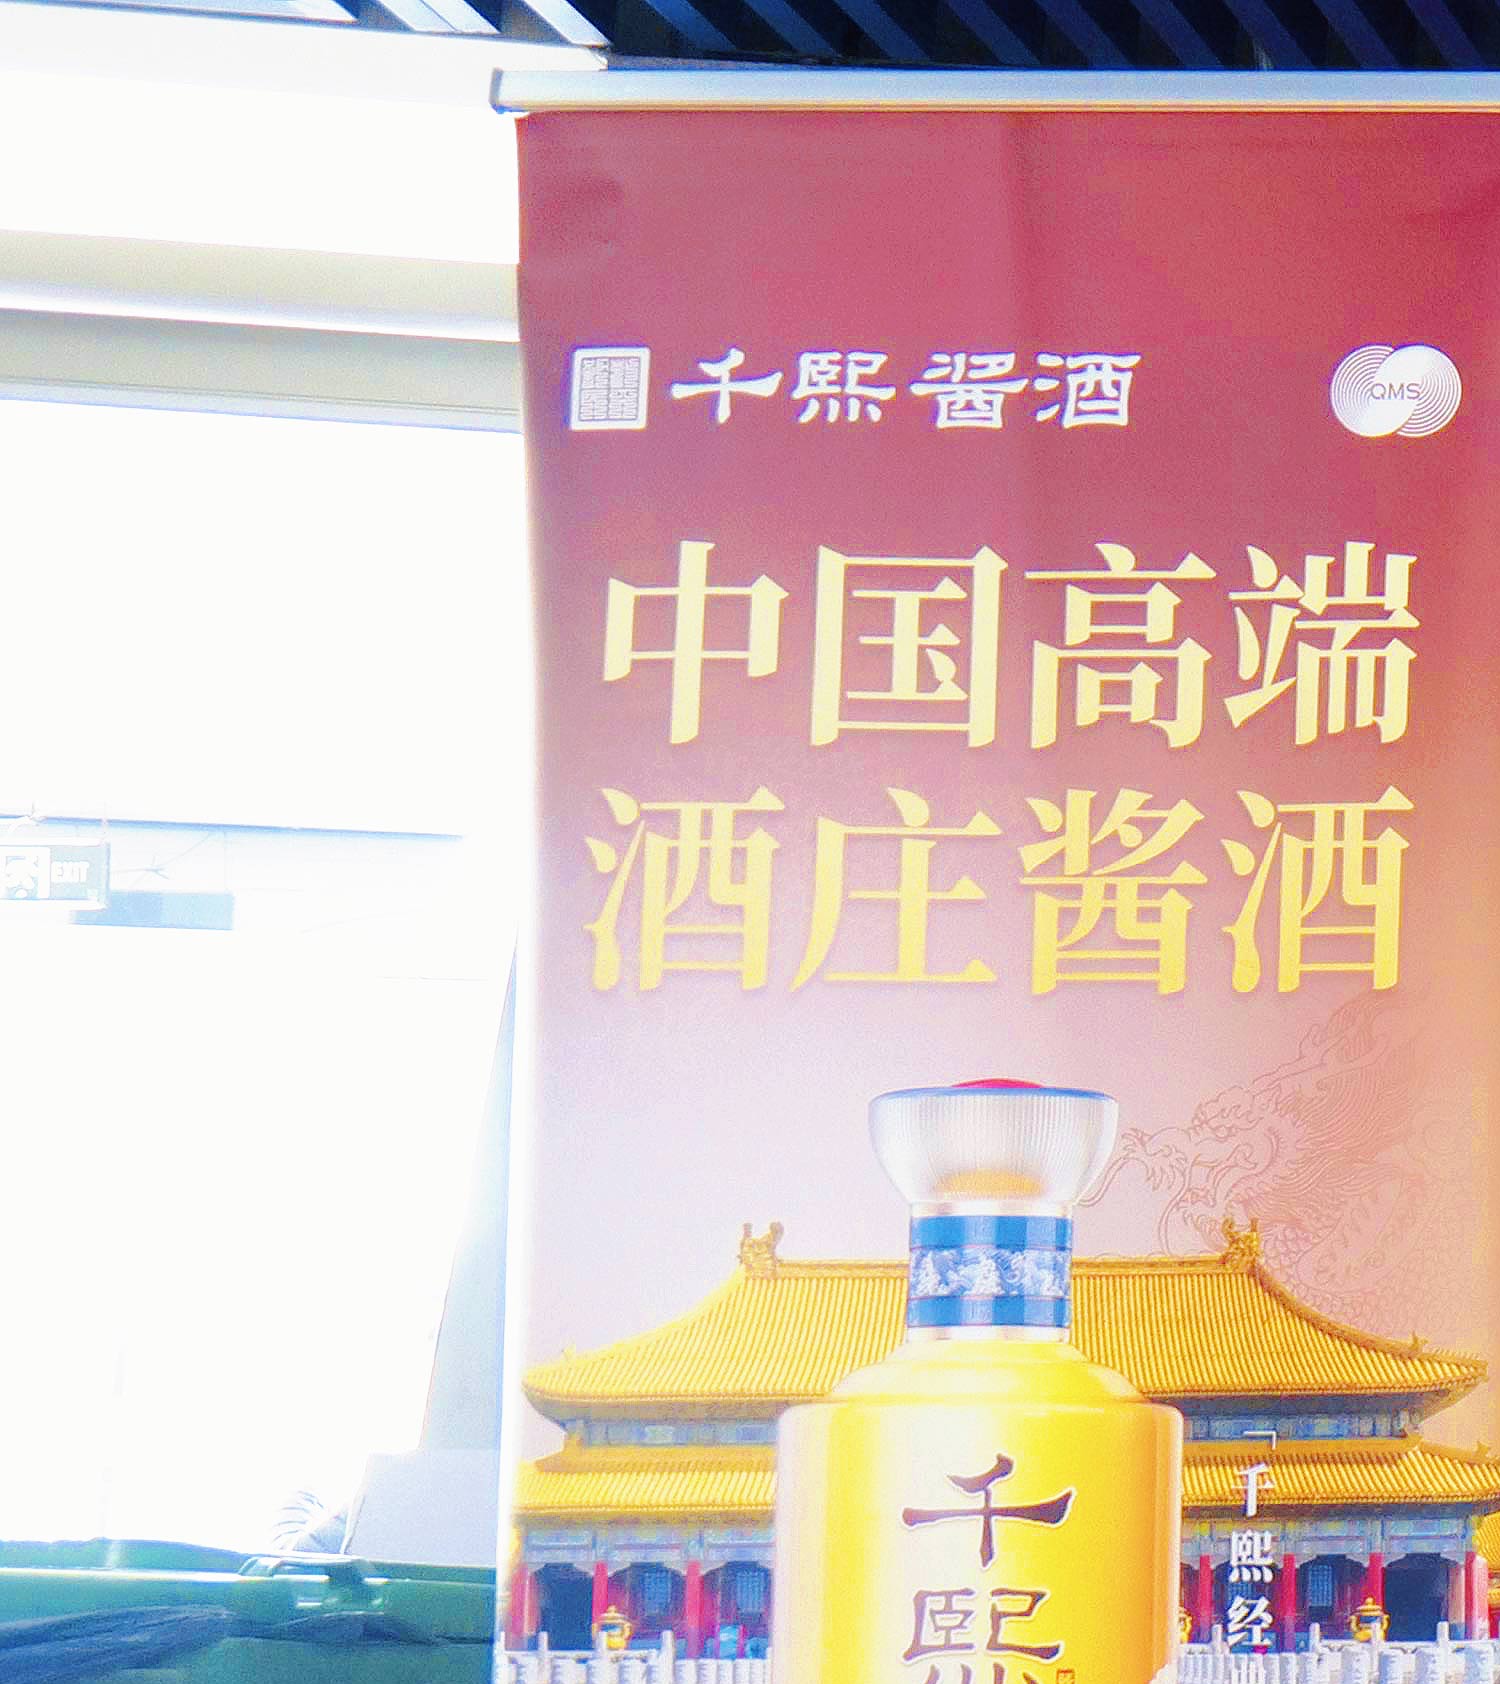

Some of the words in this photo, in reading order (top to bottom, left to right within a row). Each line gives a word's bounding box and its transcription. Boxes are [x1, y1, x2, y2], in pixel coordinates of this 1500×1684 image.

[669, 348, 1141, 430] 千熙酱酒
[1370, 382, 1421, 401] QMS
[603, 541, 1418, 749] 中国高端
[584, 785, 1415, 995] 酒庄酱酒
